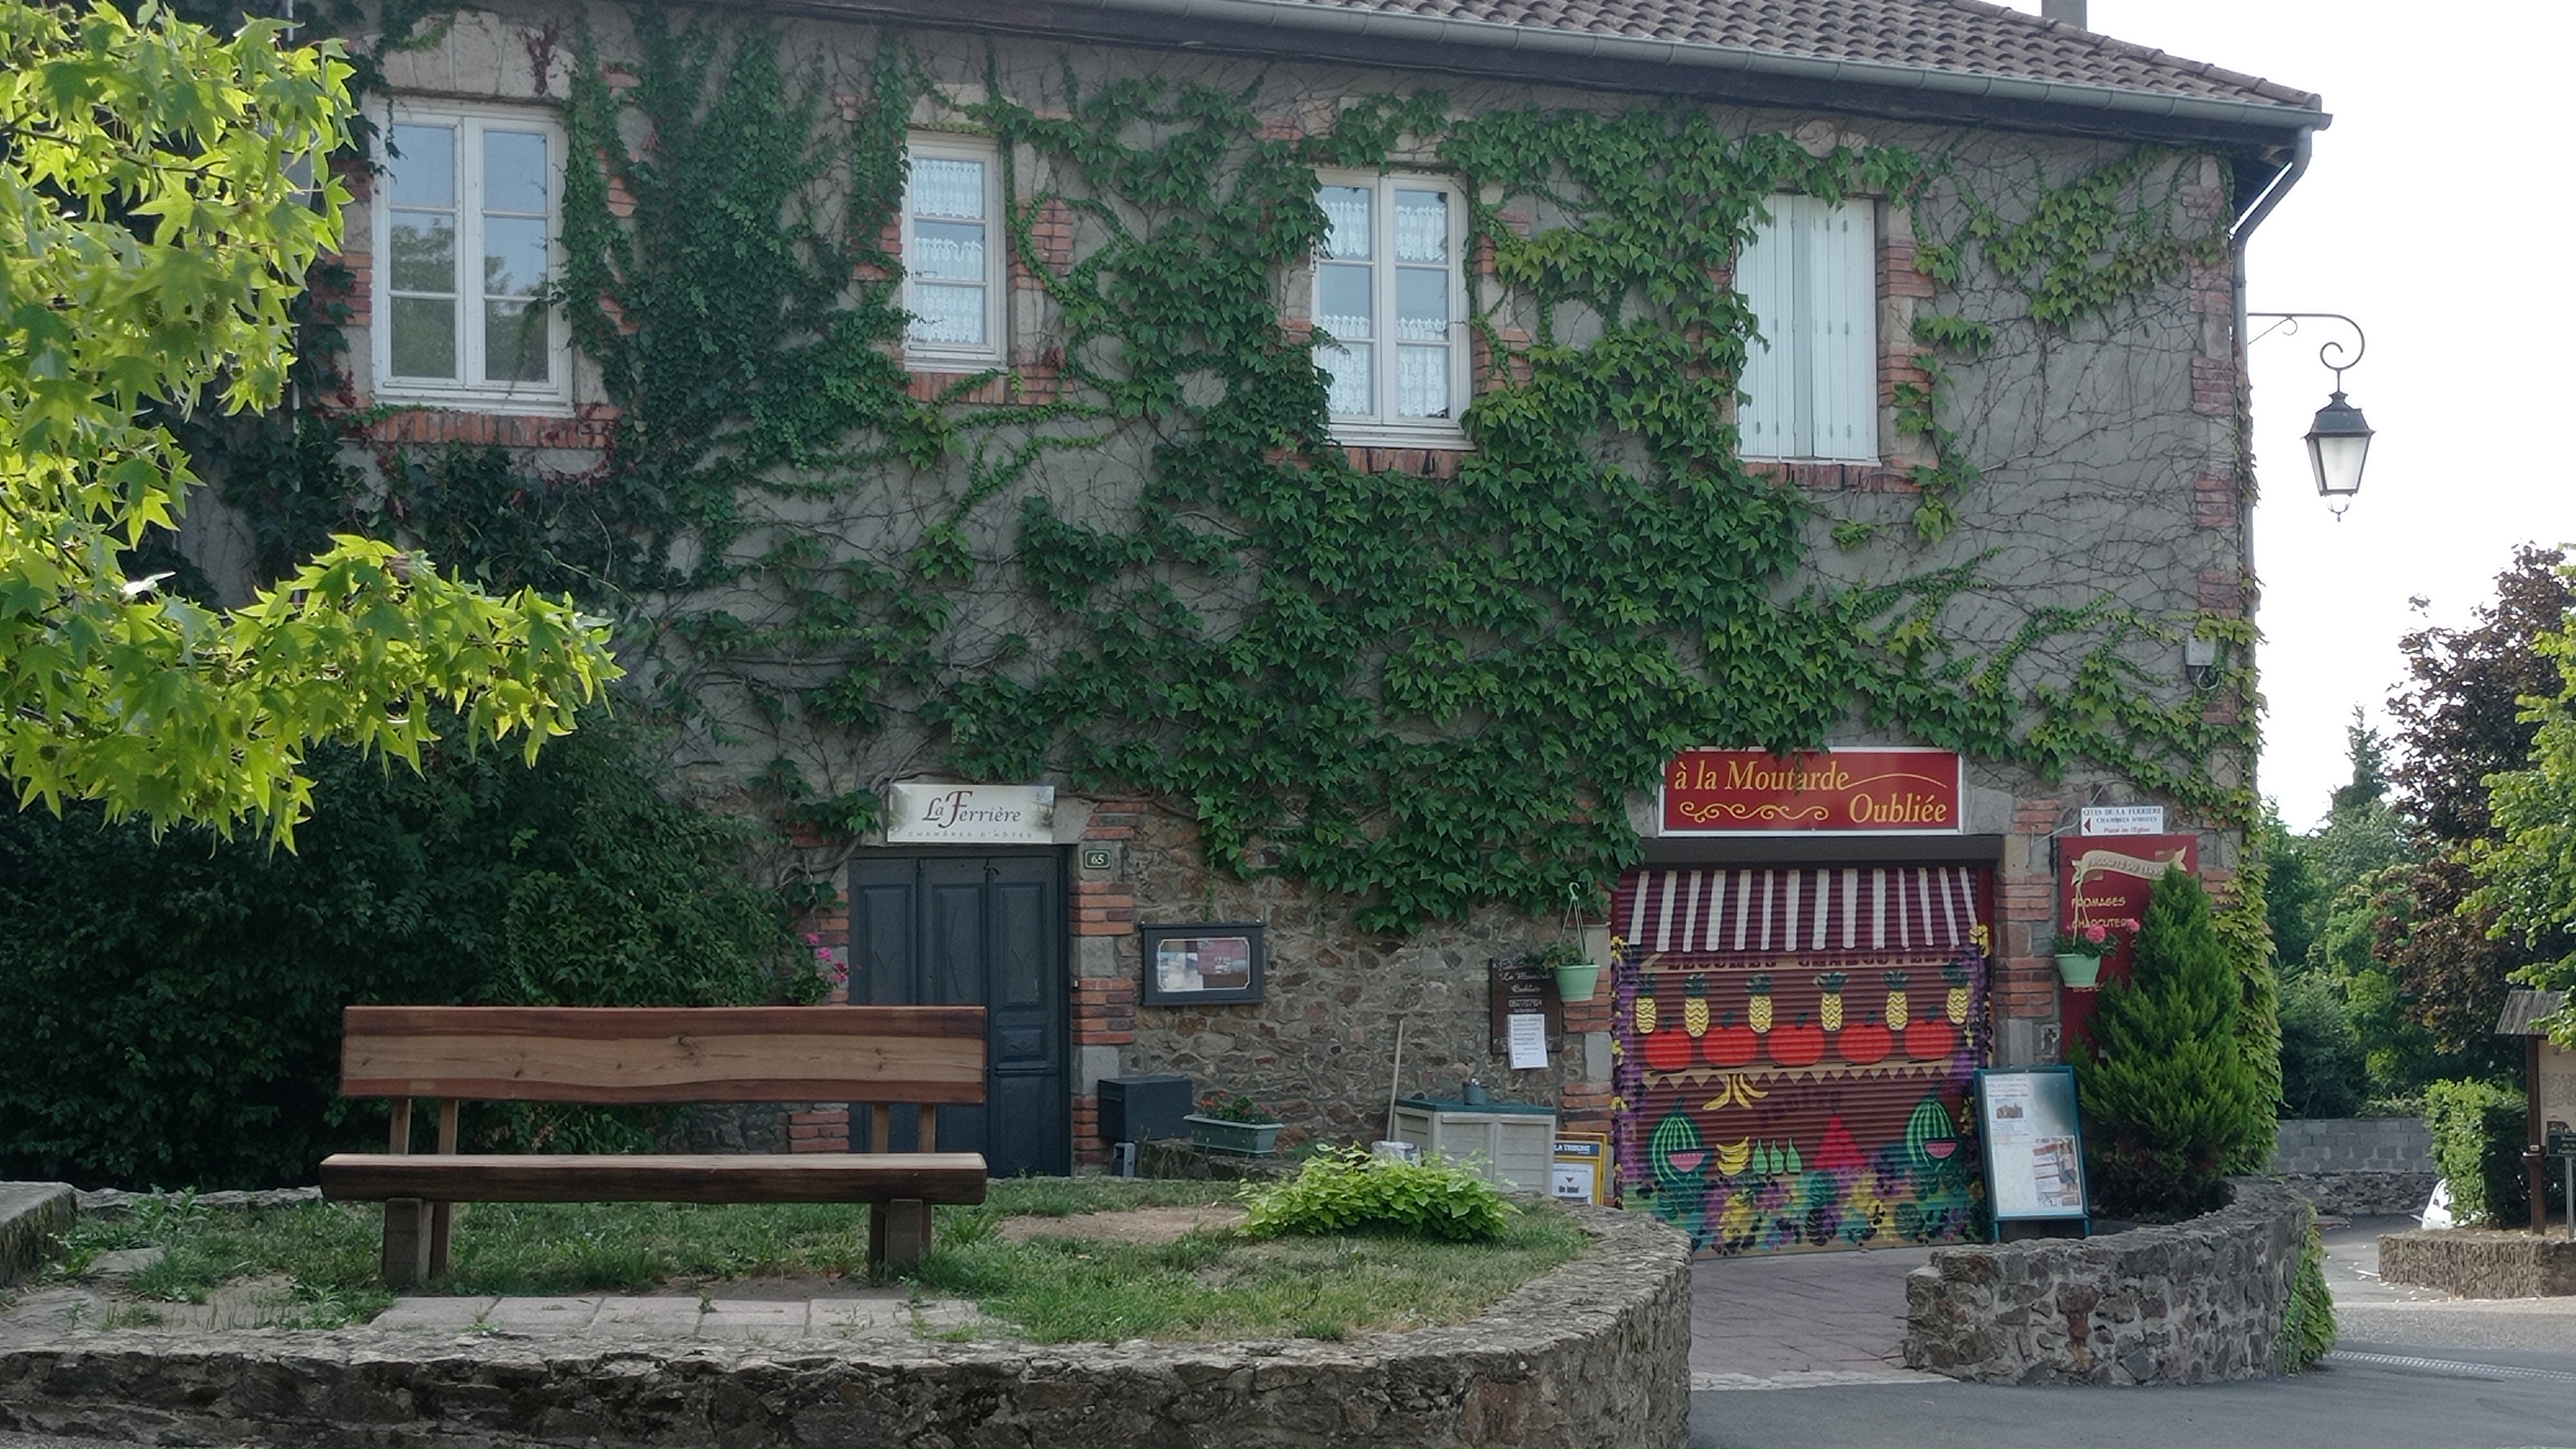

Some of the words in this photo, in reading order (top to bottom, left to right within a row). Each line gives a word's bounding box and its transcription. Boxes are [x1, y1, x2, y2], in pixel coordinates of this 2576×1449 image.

[1674, 762, 1687, 790] à
[1695, 760, 1717, 790] la
[1724, 761, 1849, 790] Moutarde
[922, 797, 943, 821] La
[938, 790, 1021, 829] Ferrière
[1849, 793, 1947, 824] Oubliée
[1091, 854, 1104, 865] 65
